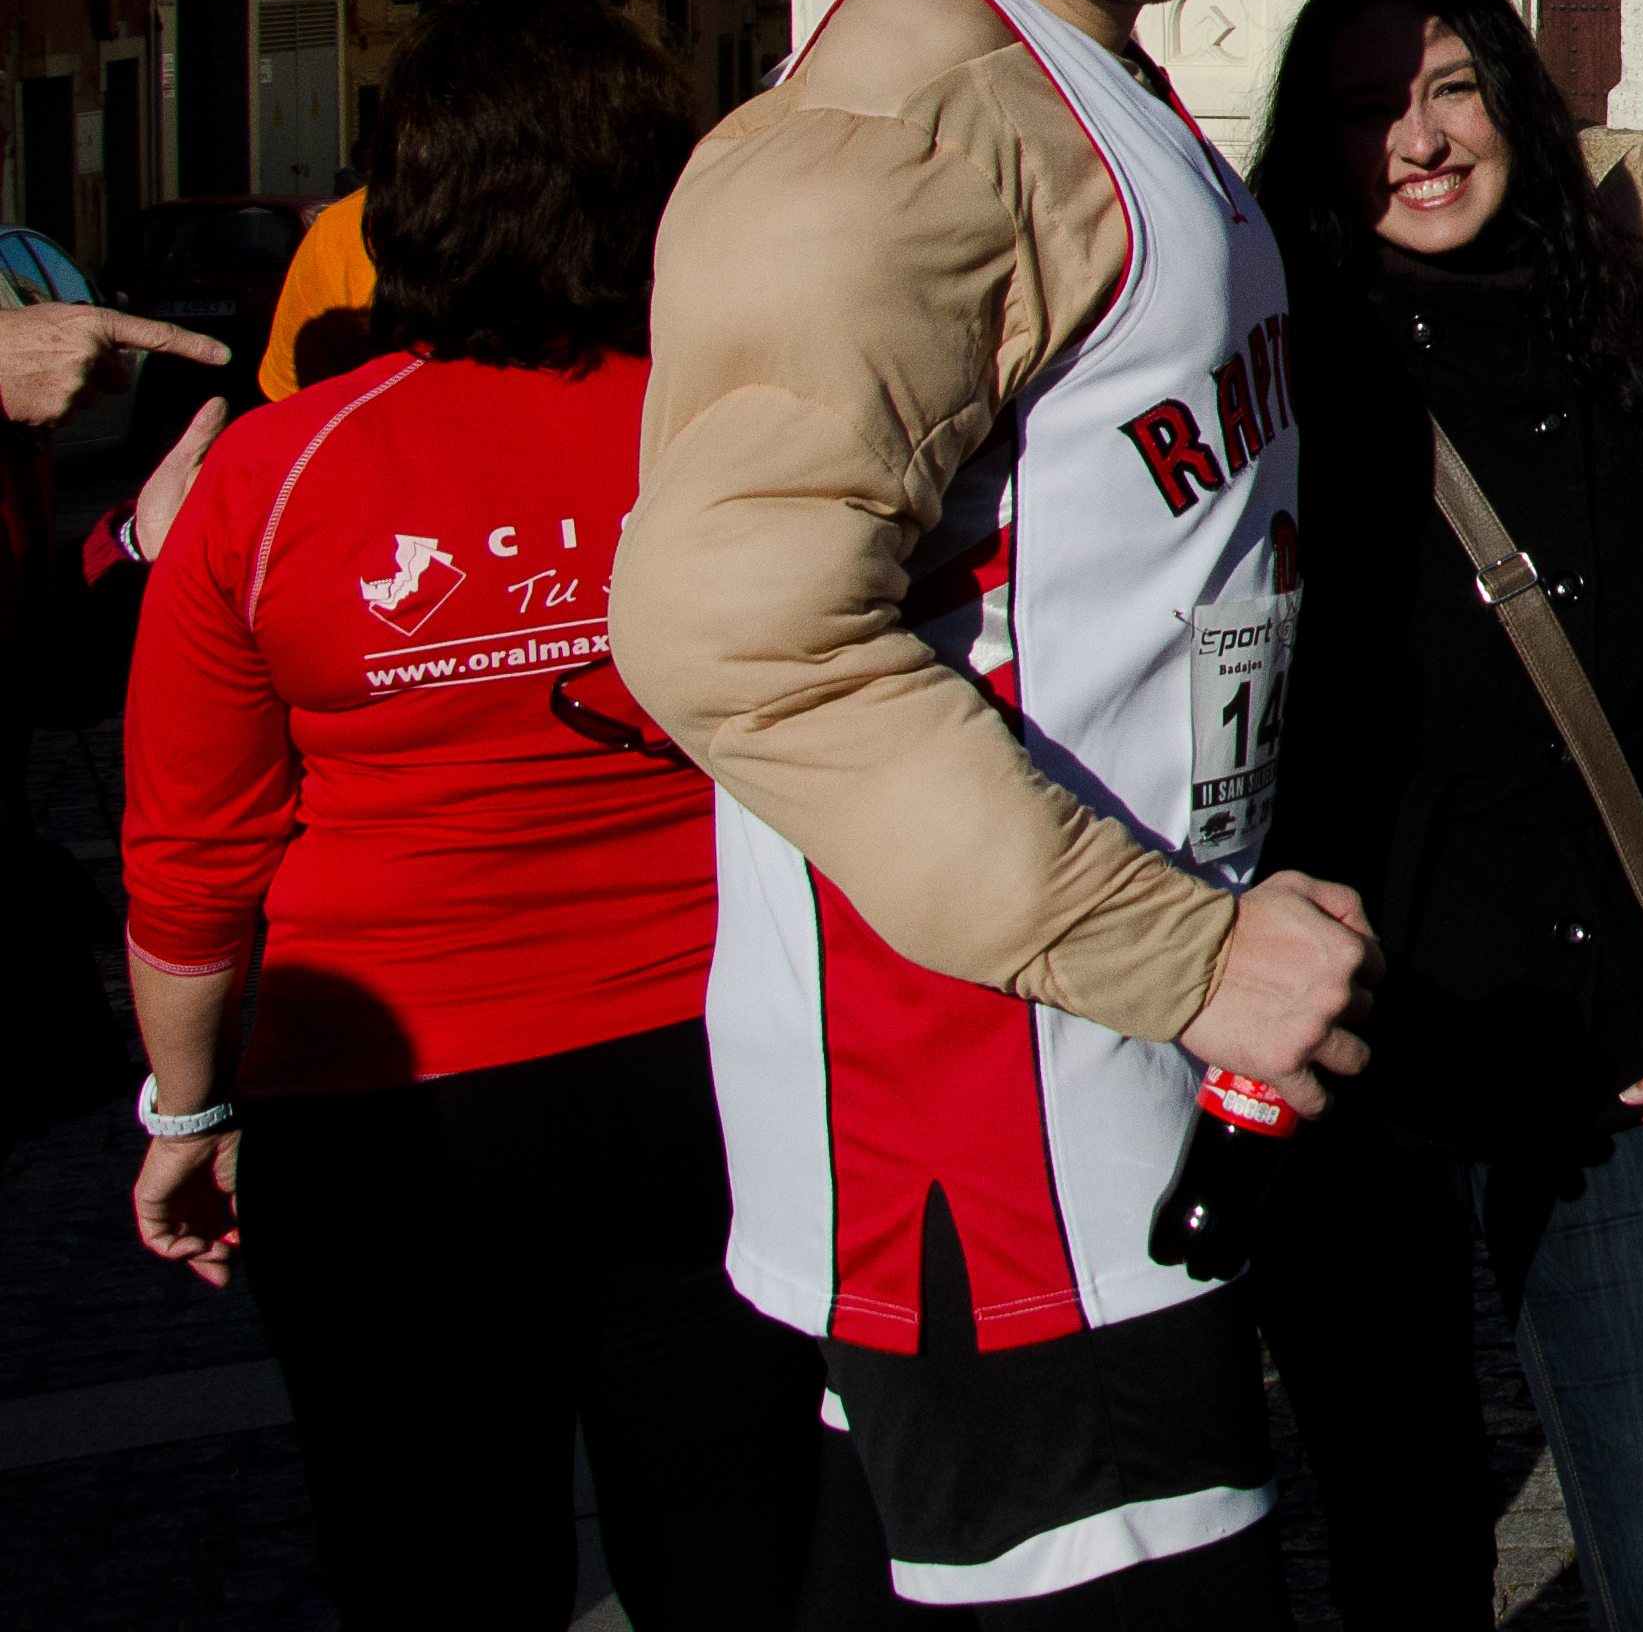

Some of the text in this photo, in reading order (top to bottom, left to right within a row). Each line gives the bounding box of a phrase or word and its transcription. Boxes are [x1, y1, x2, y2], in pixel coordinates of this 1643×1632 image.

[508, 569, 579, 613] Tu
[364, 634, 610, 688] www.oralmax
[1202, 783, 1213, 806] II
[1218, 776, 1245, 802] SAN
